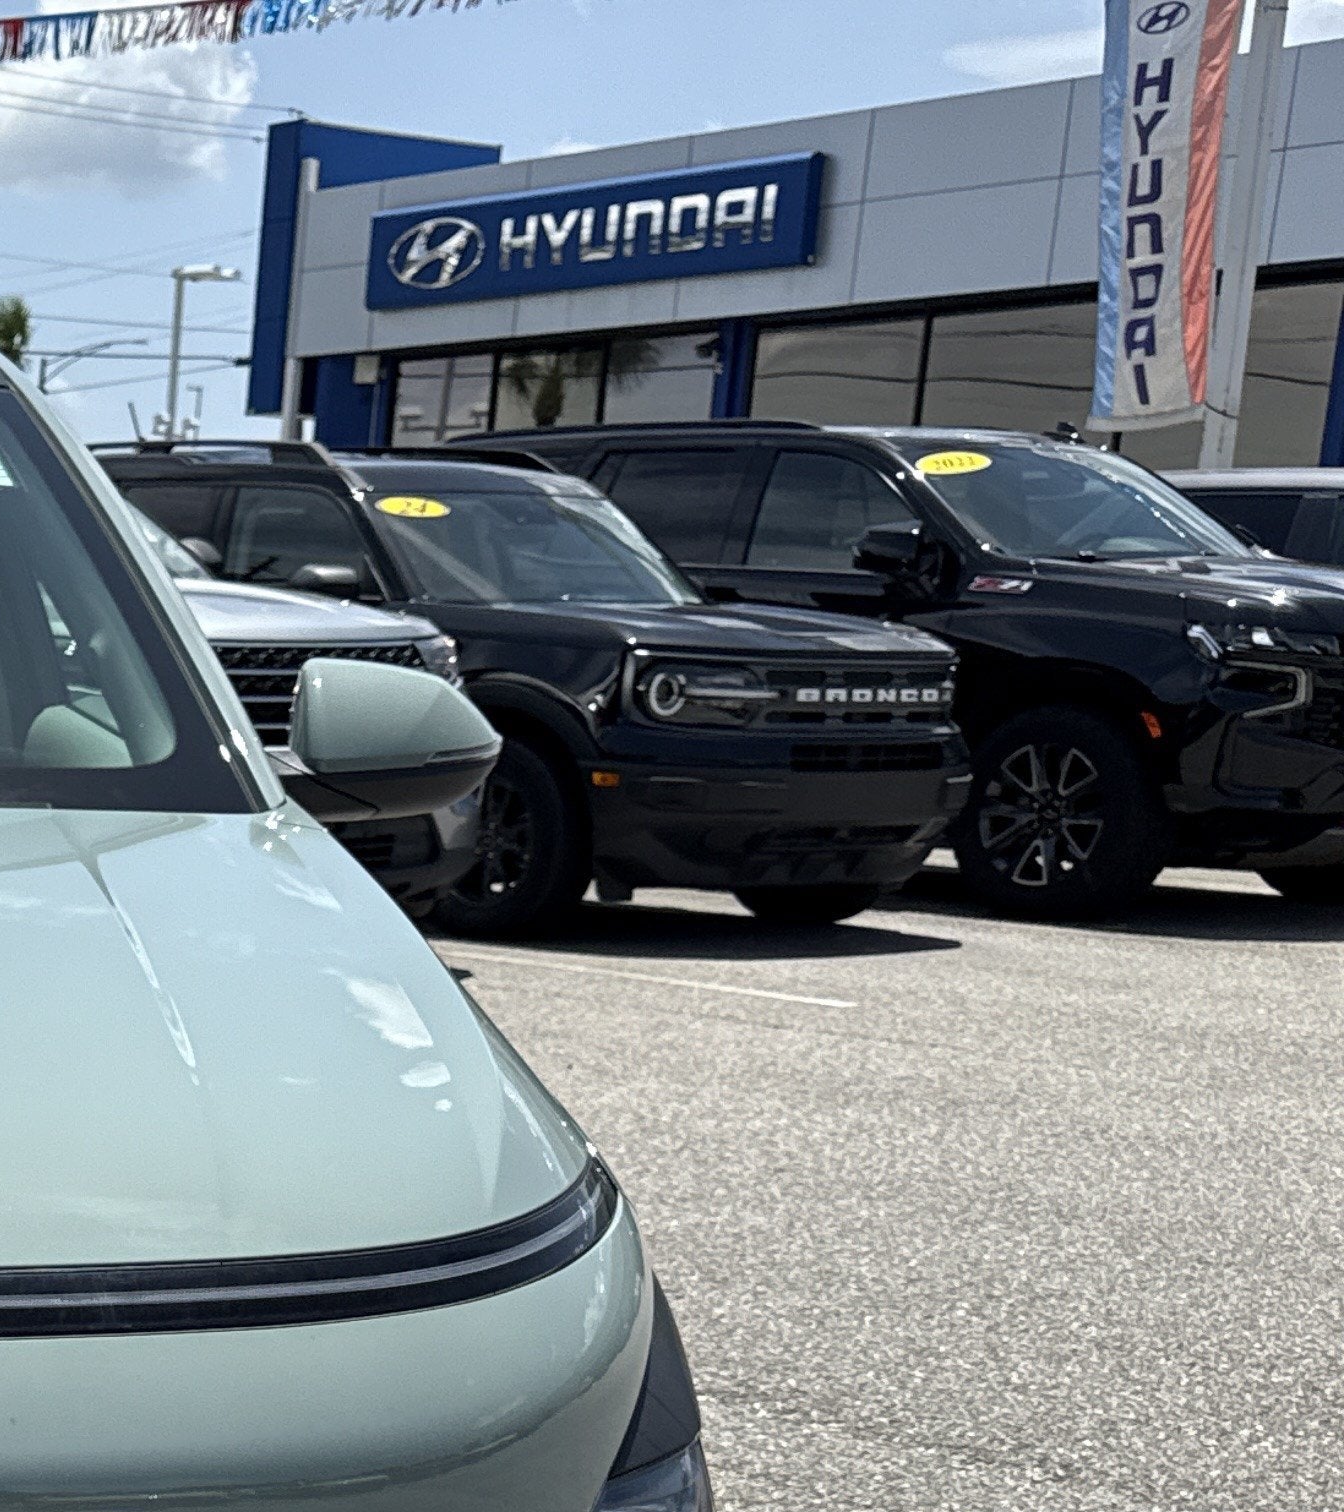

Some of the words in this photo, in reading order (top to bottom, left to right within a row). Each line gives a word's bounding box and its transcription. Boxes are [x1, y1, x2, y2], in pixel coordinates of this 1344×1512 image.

[499, 183, 779, 271] HYUNDAI
[1123, 57, 1175, 405] HYUNDAI
[796, 687, 939, 703] BRONCO
